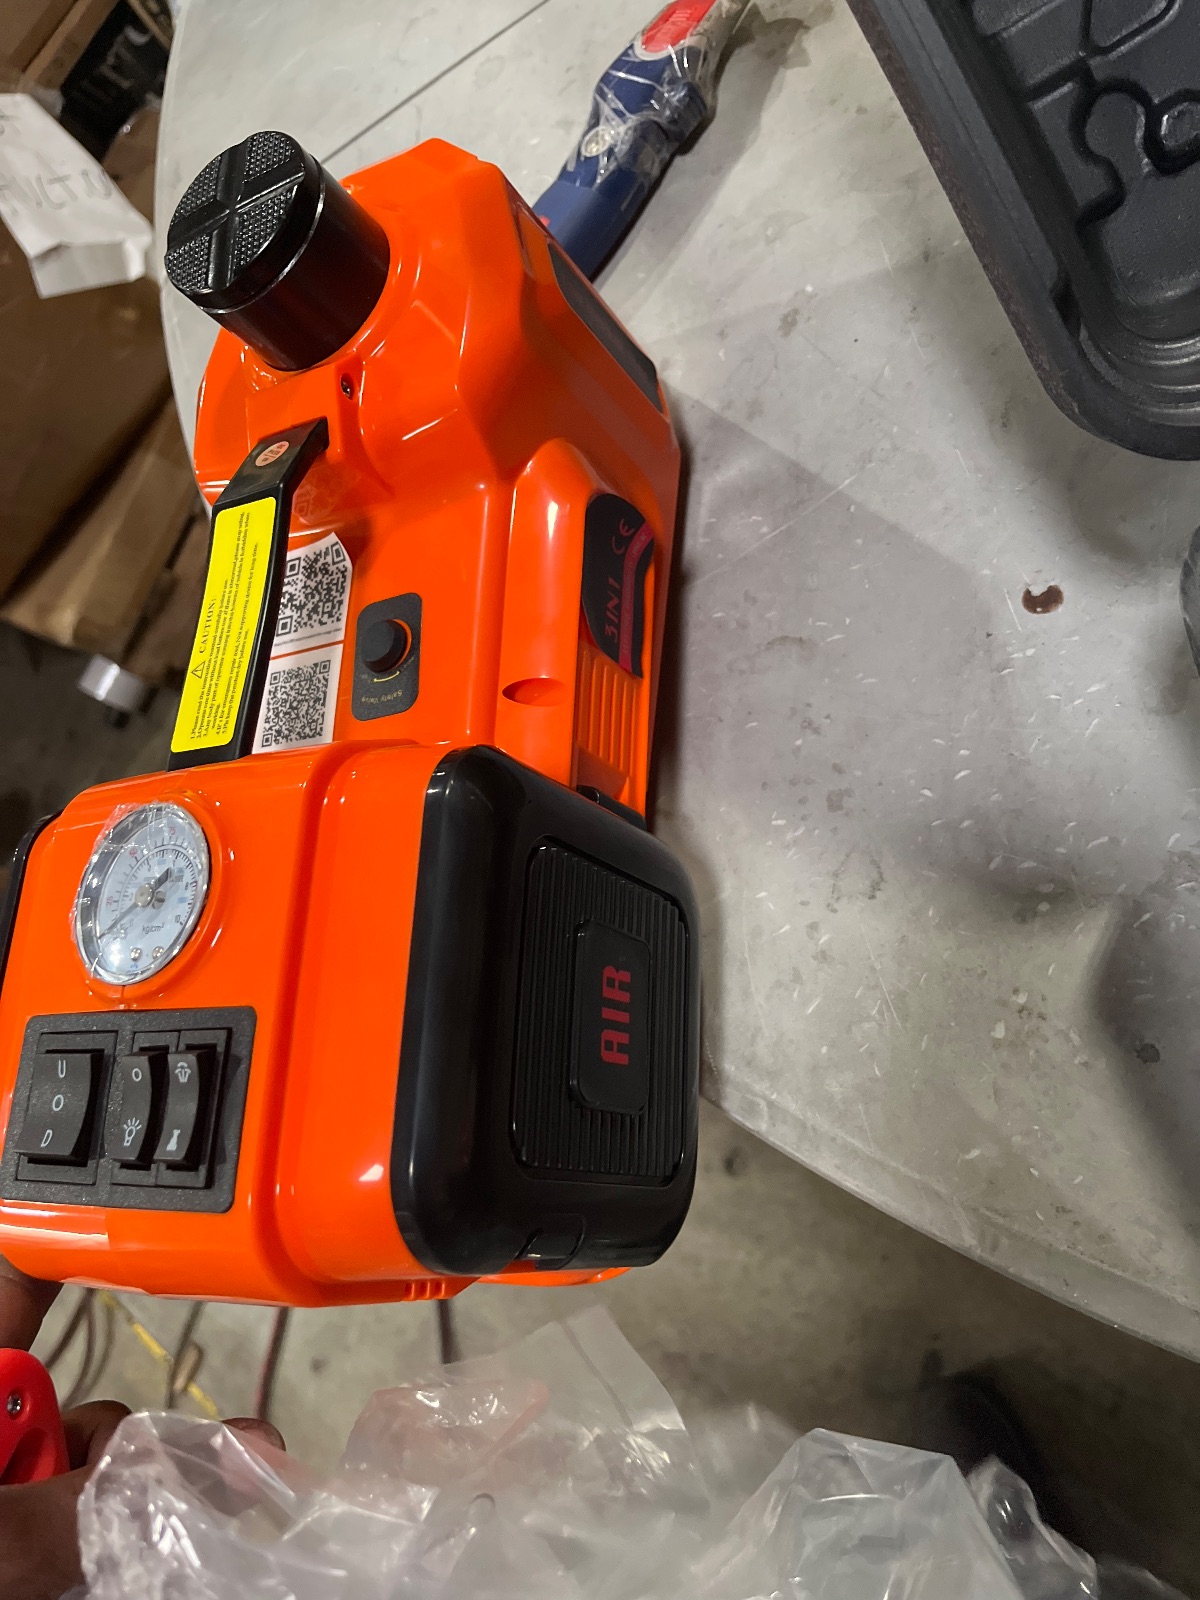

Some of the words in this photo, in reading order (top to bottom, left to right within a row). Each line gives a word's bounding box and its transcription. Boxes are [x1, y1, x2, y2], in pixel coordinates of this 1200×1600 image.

[199, 599, 215, 653] CAUTION:
[601, 966, 631, 1066] AIR
[58, 1059, 66, 1078] U
[40, 1129, 52, 1147] D
